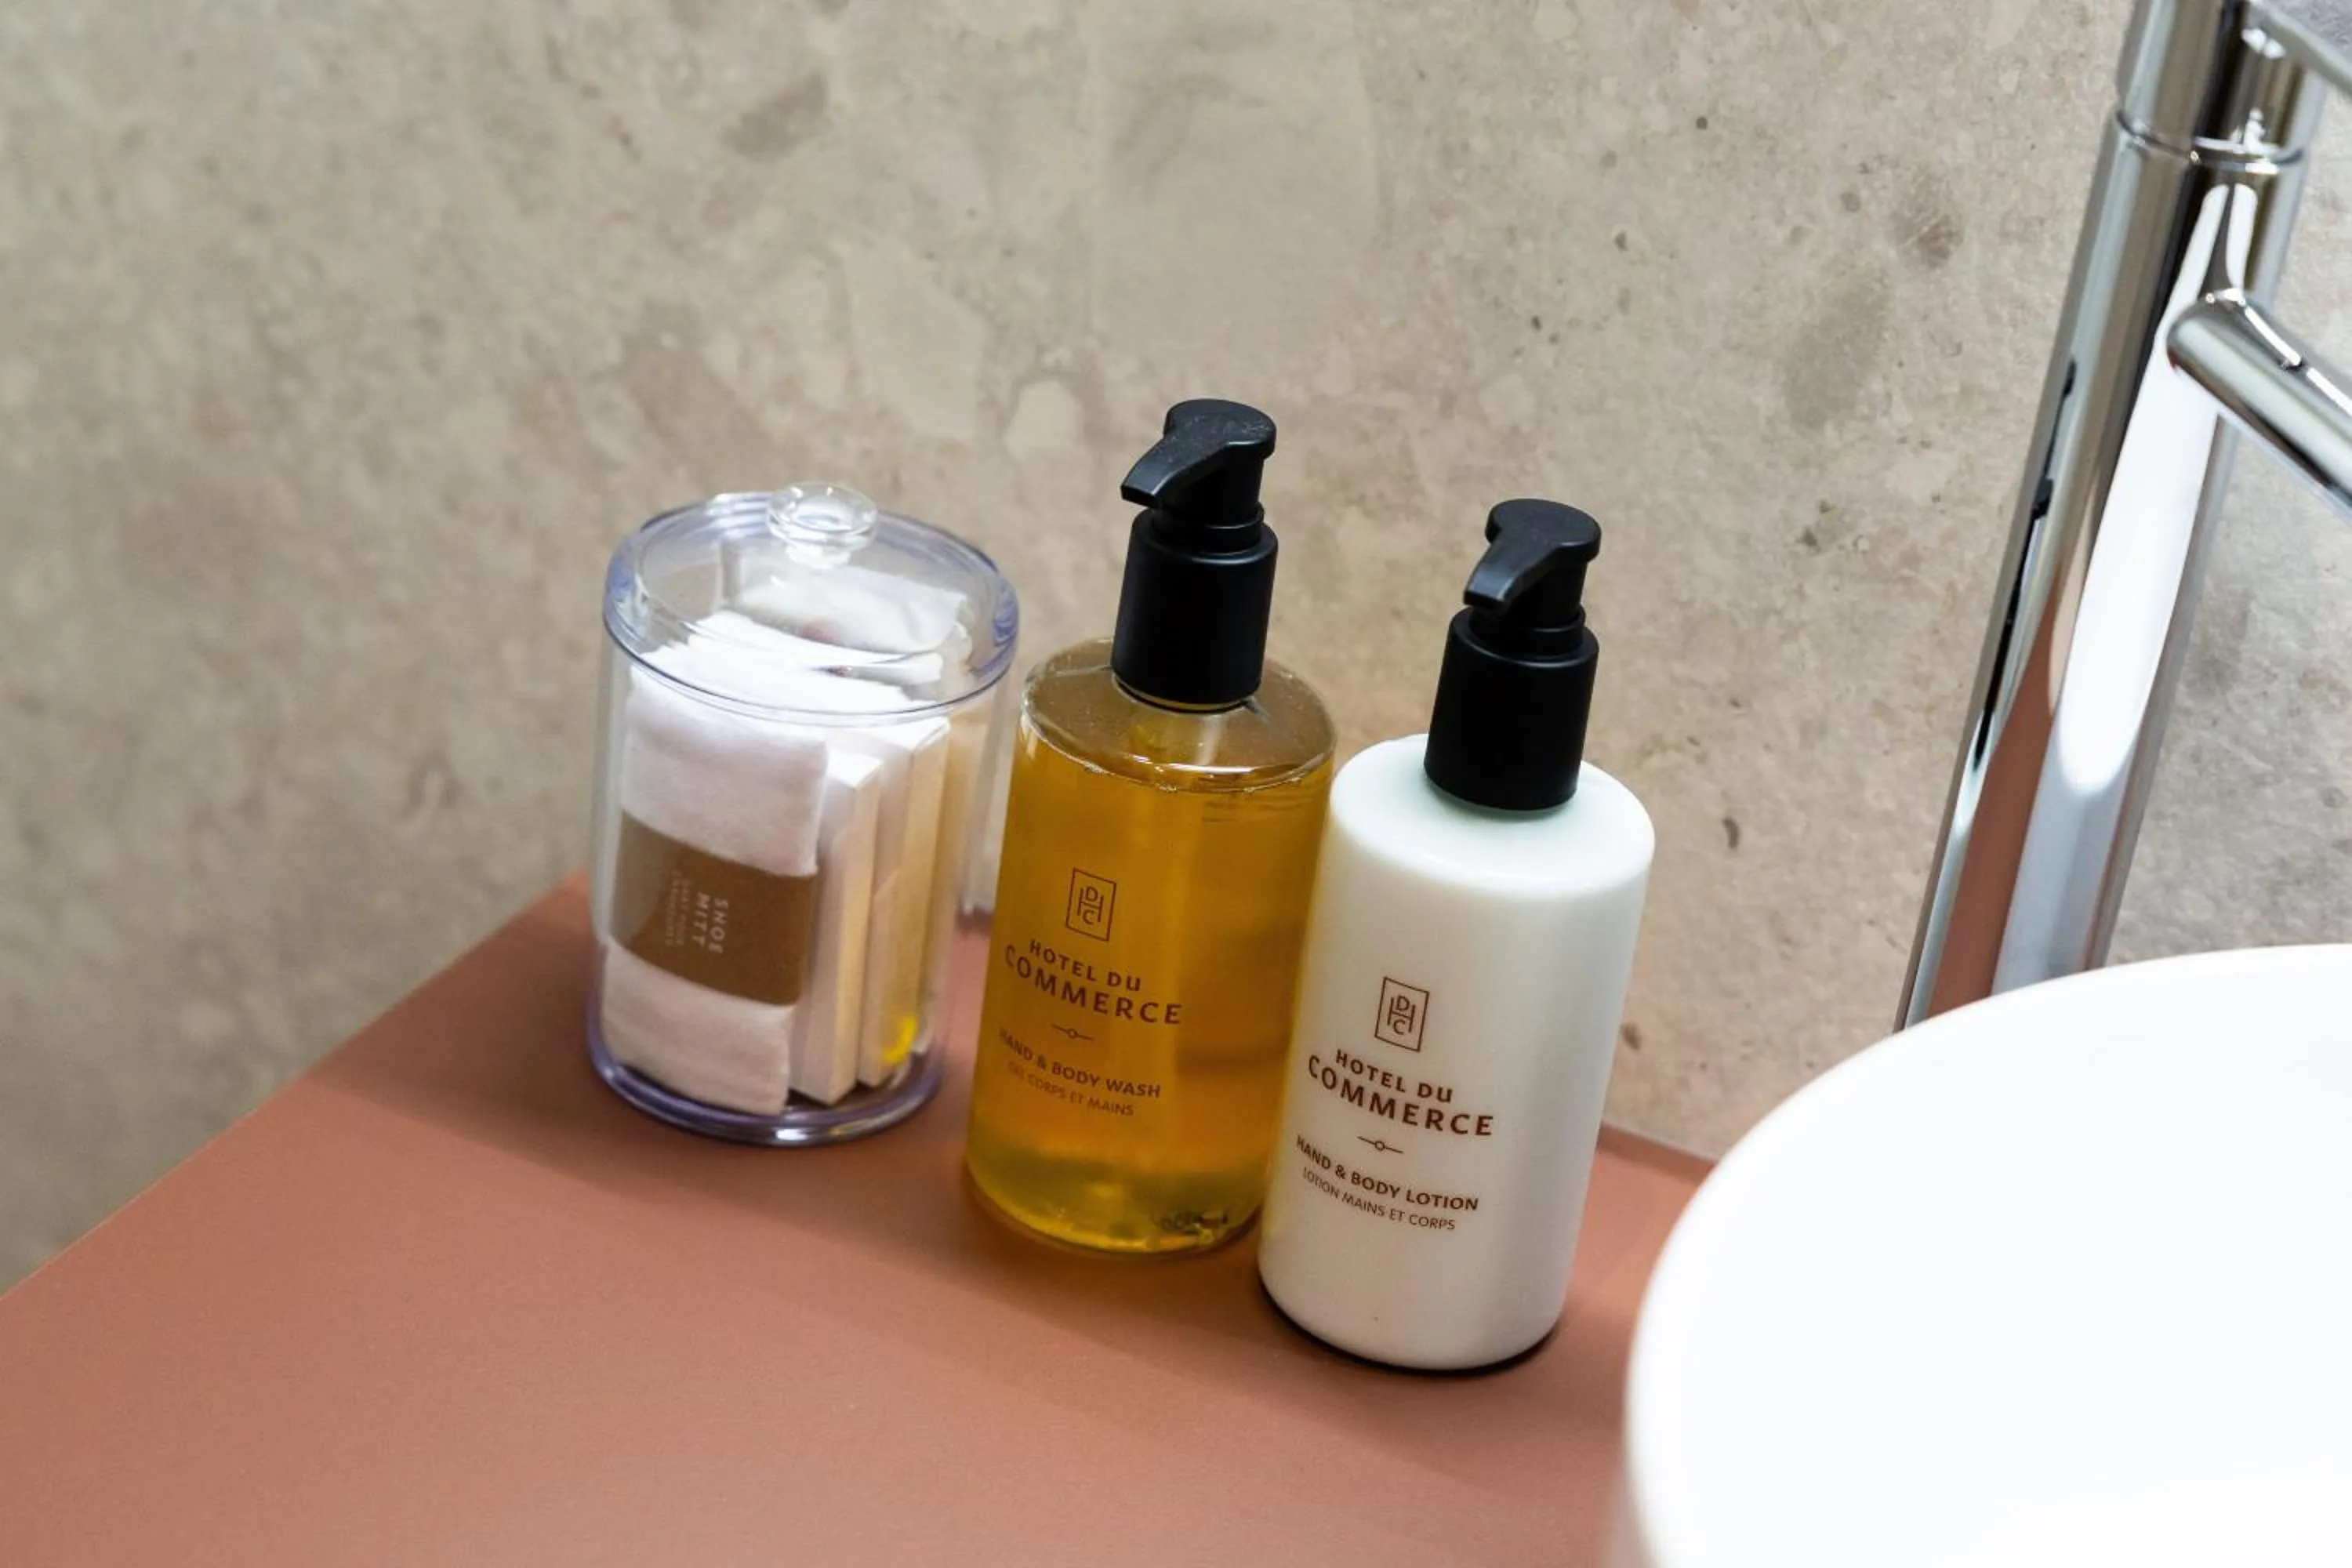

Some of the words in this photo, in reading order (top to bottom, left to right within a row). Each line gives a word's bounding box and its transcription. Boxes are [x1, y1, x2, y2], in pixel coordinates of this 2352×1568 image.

[692, 891, 710, 947] MITT
[1005, 944, 1182, 1025] COMMERCE
[1030, 939, 1096, 982] HOTEL
[1107, 971, 1141, 991] DU
[999, 1027, 1033, 1061] HAND
[1036, 1054, 1047, 1071] &
[1051, 1062, 1100, 1087] BODY
[1105, 1077, 1161, 1098] WASH
[1308, 1054, 1494, 1136] COMMERCE
[1336, 1048, 1406, 1093] HOTEL
[1417, 1082, 1453, 1104] DU
[1069, 1091, 1084, 1105] ET
[1087, 1097, 1134, 1116] MAINS
[1297, 1135, 1330, 1170] HAND
[1335, 1164, 1346, 1180] &
[1351, 1171, 1400, 1198] BODY
[1406, 1189, 1479, 1211] LOTION
[1302, 1166, 1340, 1200] LOTION
[1342, 1191, 1385, 1217] MAINS
[1388, 1208, 1405, 1222] ET
[1410, 1214, 1456, 1231] CORPS
